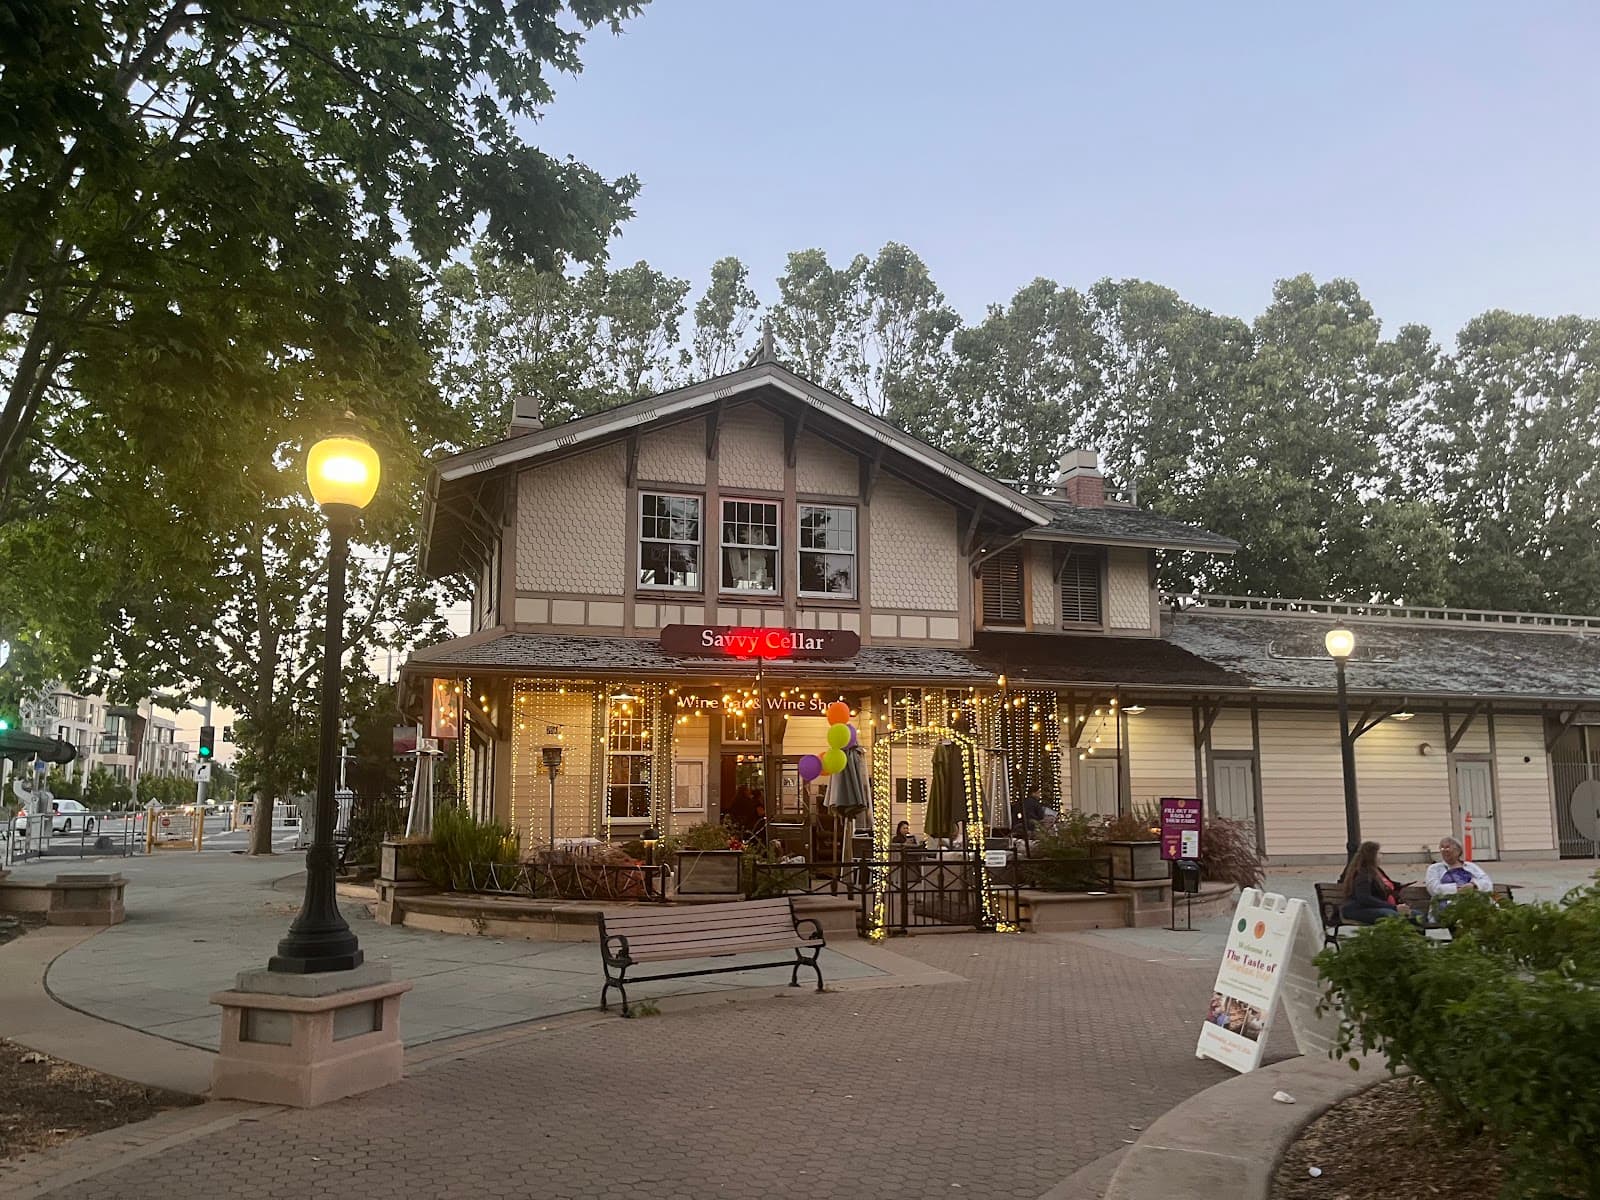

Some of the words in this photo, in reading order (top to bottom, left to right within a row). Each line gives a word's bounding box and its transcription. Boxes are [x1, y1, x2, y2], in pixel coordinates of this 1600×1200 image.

[701, 629, 759, 652] Savvy
[765, 632, 825, 650] Cellar
[678, 696, 719, 709] Wine
[767, 698, 806, 710] Wine
[809, 699, 841, 711] Sho
[1227, 949, 1241, 961] The
[1243, 954, 1265, 970] Taste
[1266, 963, 1278, 974] of
